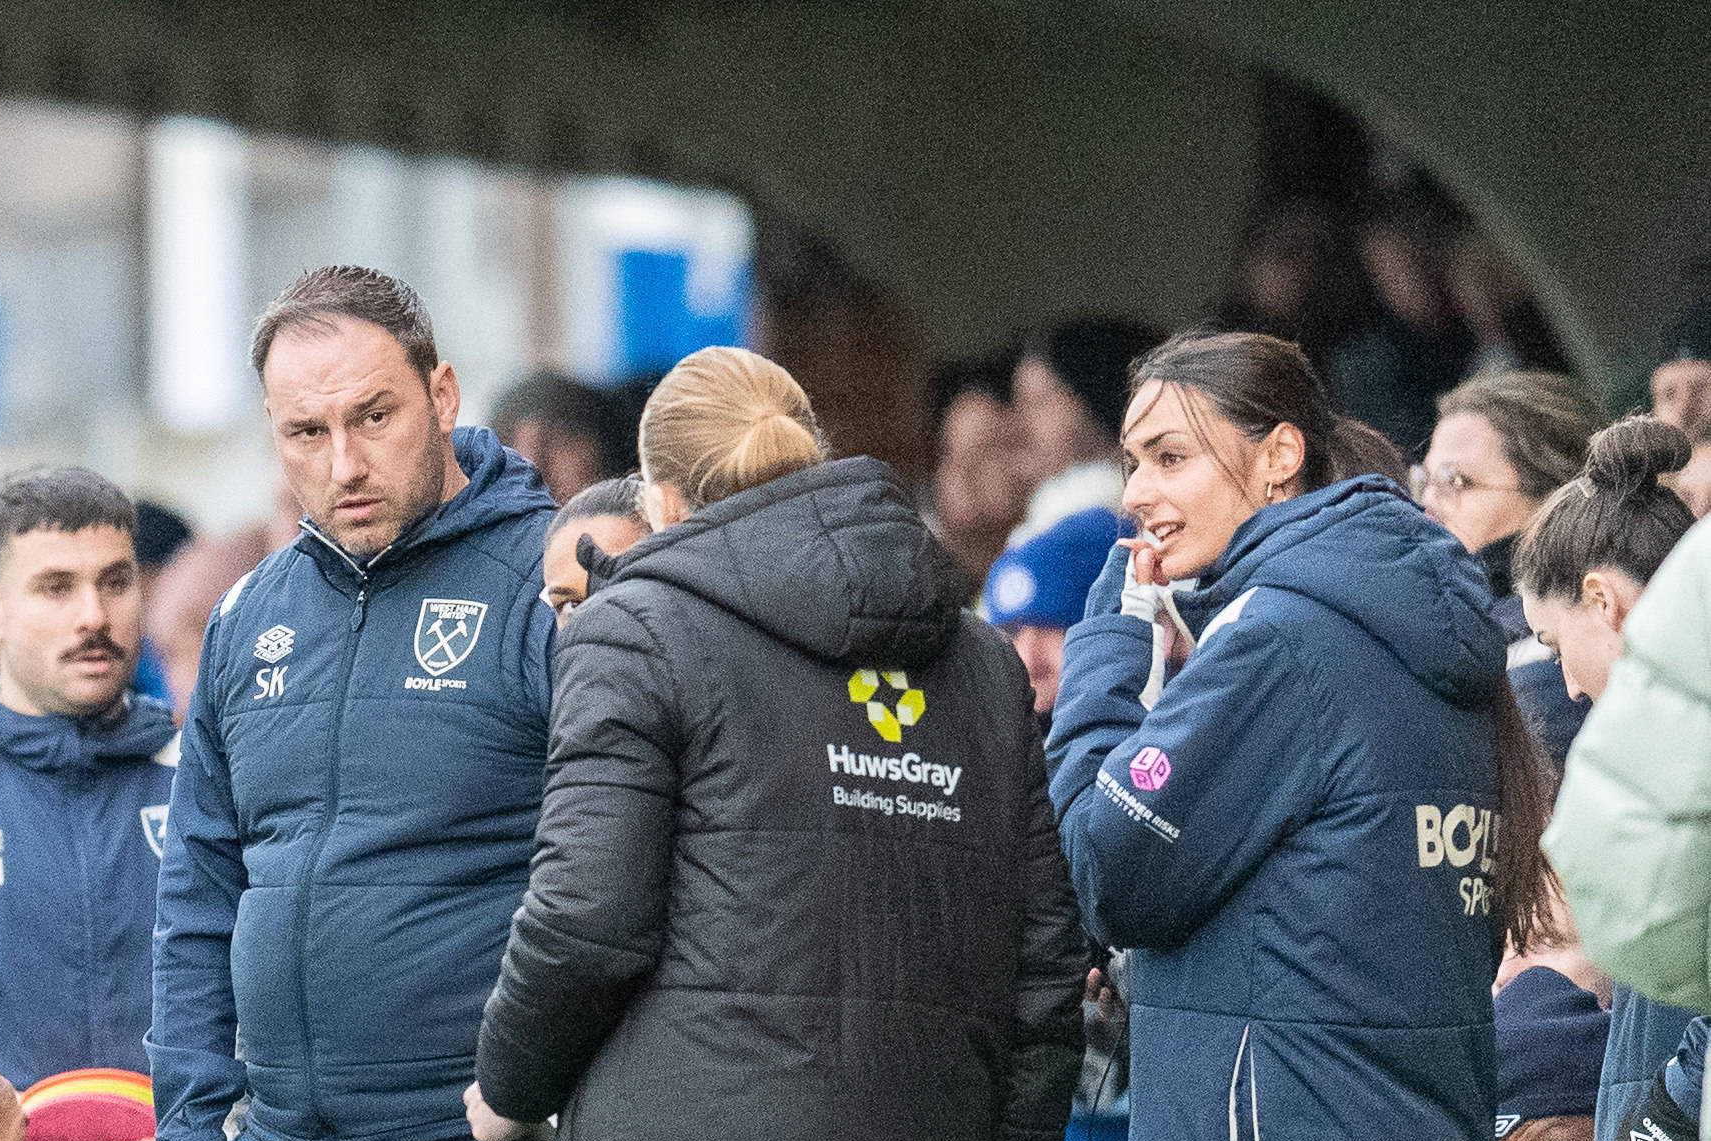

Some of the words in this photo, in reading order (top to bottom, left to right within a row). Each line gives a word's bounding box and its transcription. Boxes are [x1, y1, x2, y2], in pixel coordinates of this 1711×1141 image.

[253, 665, 289, 699] SK
[826, 743, 963, 796] HuwsGray
[833, 785, 894, 816] Building
[895, 794, 962, 822] Supplies
